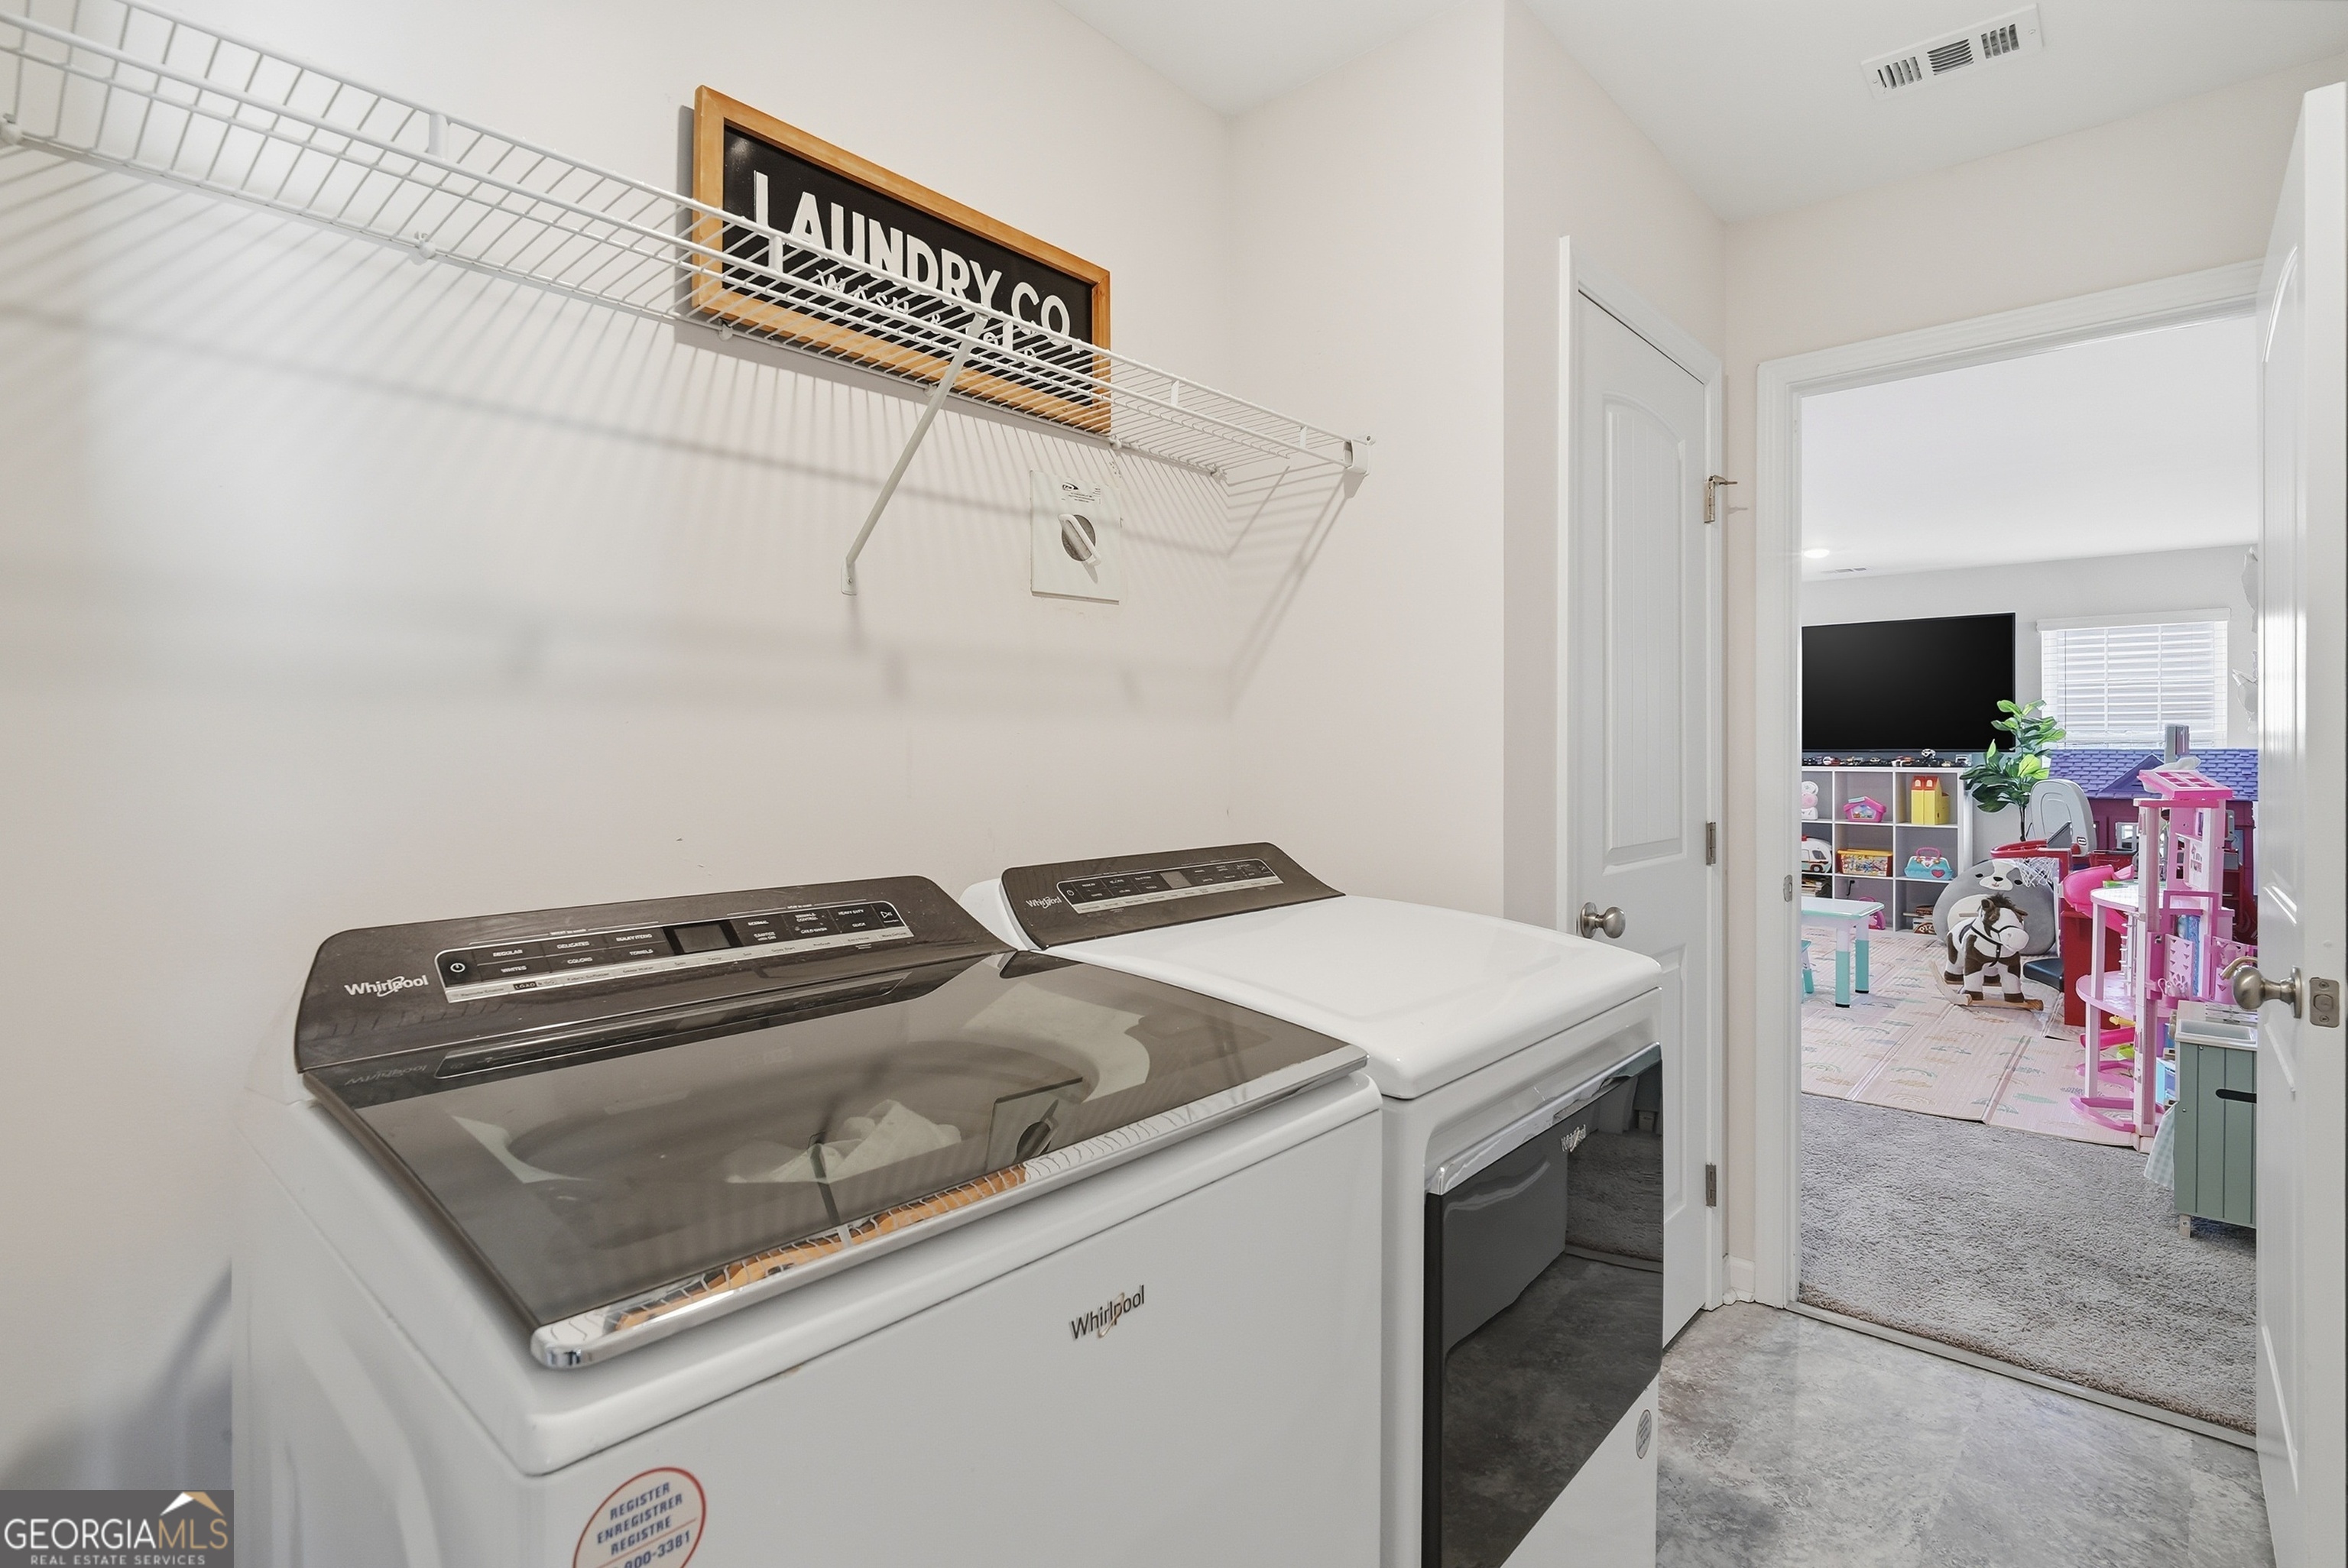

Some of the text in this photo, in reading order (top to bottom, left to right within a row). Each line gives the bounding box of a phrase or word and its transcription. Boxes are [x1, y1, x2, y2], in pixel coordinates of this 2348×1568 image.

[753, 170, 1003, 314] LAUNDRY
[344, 975, 429, 996] Whirlpool
[1071, 1285, 1145, 1340] Whirlpool
[597, 1493, 683, 1545] ENREGISTRER
[610, 1482, 670, 1521] REGISTER
[611, 1515, 671, 1556] REGISTRE
